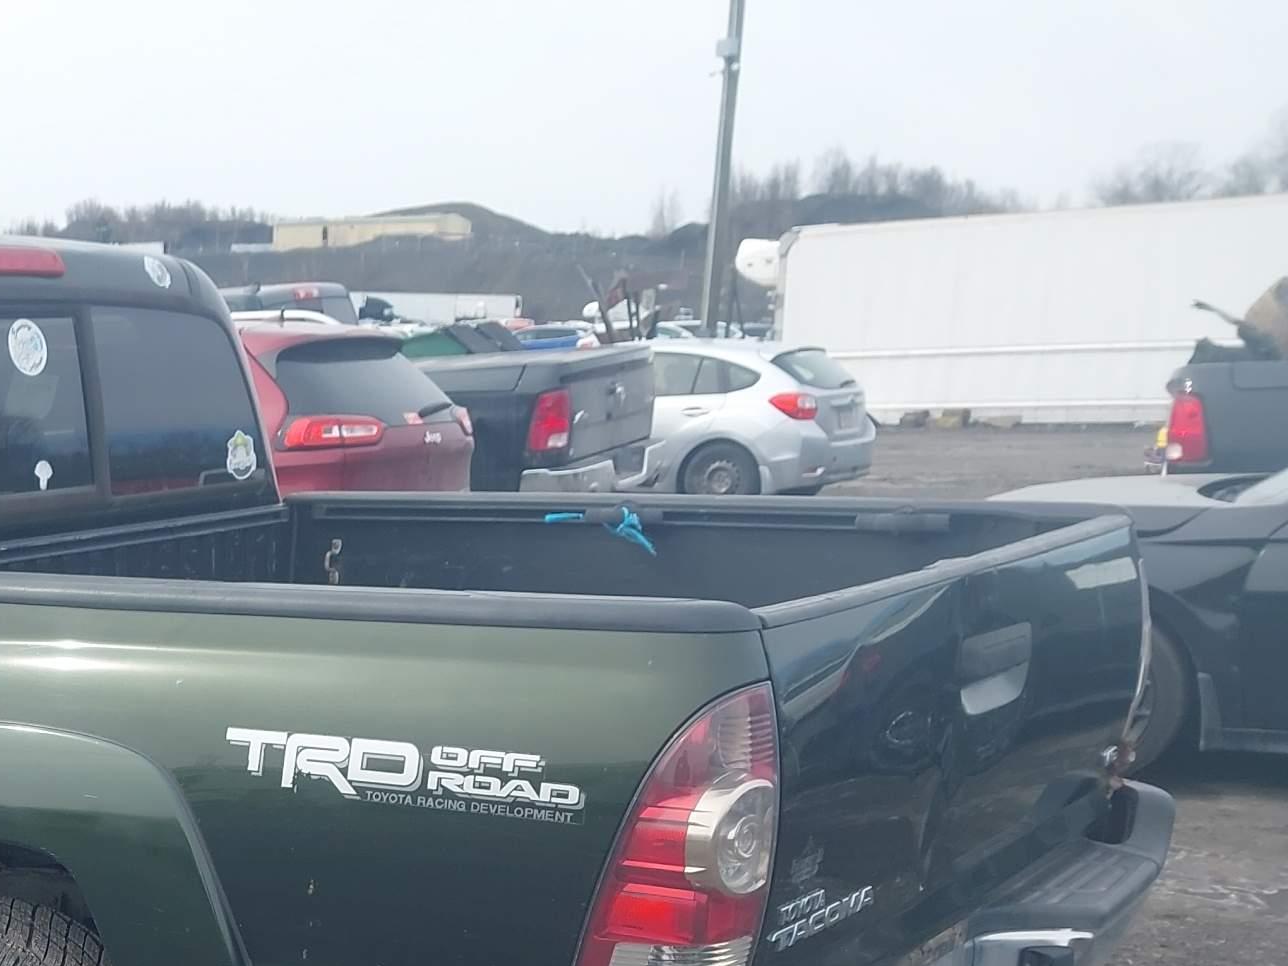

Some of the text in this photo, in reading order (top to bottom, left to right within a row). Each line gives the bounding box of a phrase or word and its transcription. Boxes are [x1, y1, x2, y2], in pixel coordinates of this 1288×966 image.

[225, 726, 424, 801] TRD
[431, 745, 546, 776] OFF
[365, 790, 573, 824] TOYOTA RACING DEVELOPMENT
[426, 769, 586, 810] ROAD
[766, 885, 875, 952] TACOMA
